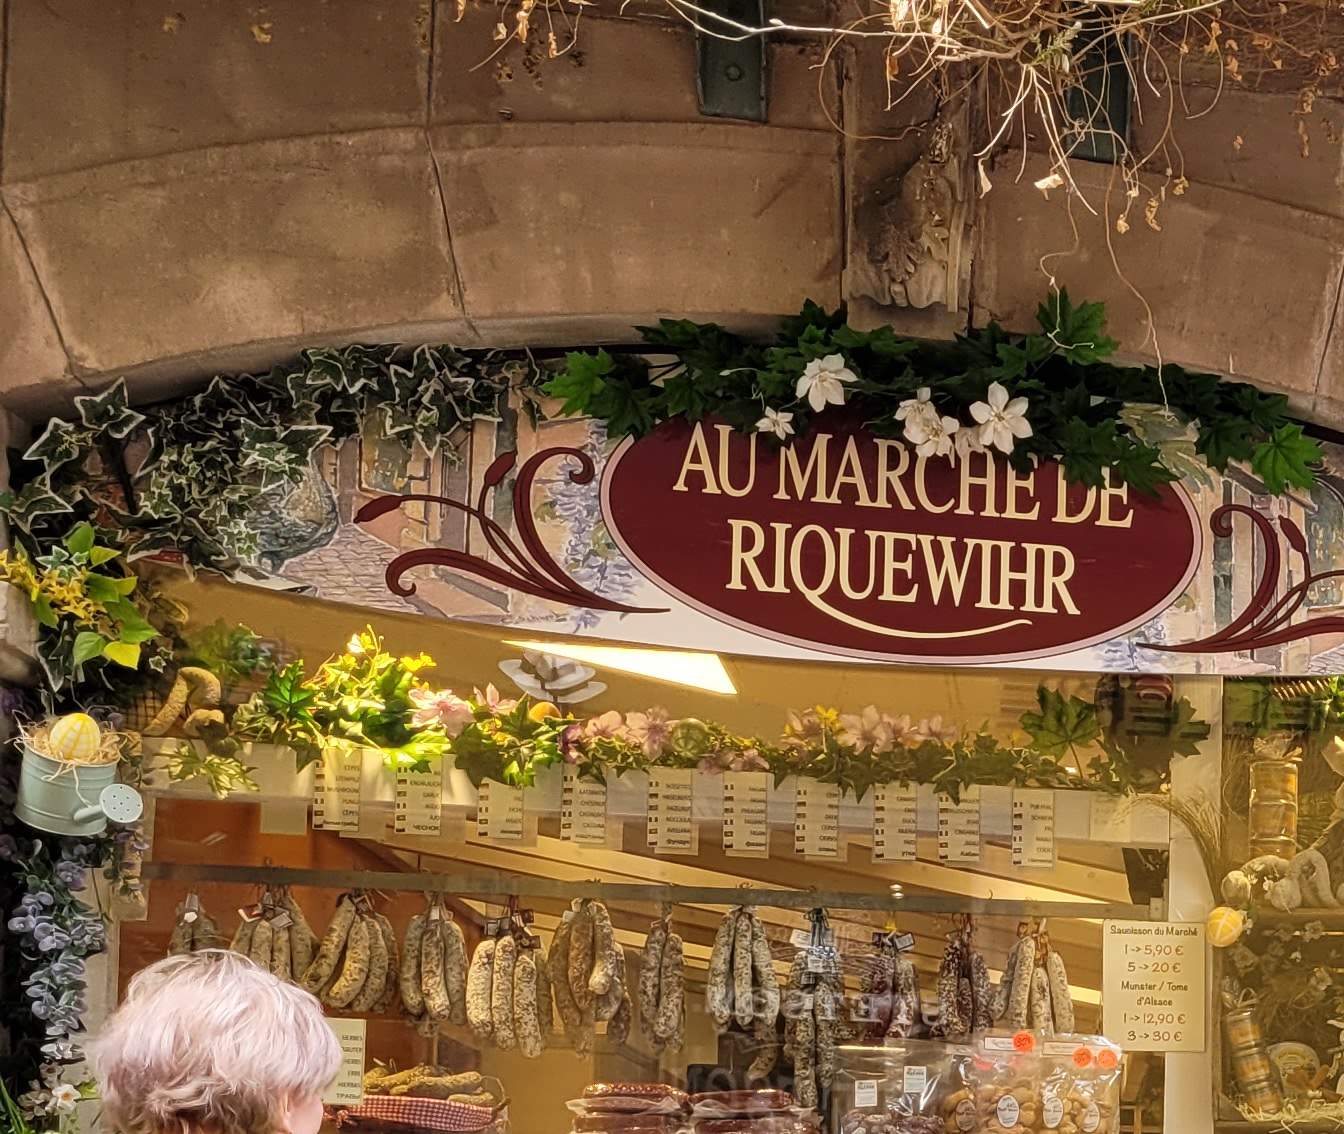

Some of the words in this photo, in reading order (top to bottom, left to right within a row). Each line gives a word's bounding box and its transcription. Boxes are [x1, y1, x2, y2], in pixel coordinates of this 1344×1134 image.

[672, 420, 758, 498] AU
[1051, 453, 1135, 529] DE
[725, 517, 1081, 640] RIQUEWIHR
[1154, 926, 1165, 936] du
[1165, 926, 1198, 937] Marché
[1144, 944, 1173, 958] 5,90
[1127, 961, 1137, 973] 5
[1151, 962, 1170, 973] 20
[1120, 980, 1157, 992] Munster
[1166, 981, 1189, 992] Tome
[1136, 996, 1173, 1007] d'Alsace
[1143, 1013, 1175, 1026] 12,90
[1127, 1030, 1137, 1042] 3
[1152, 1031, 1171, 1042] 30
